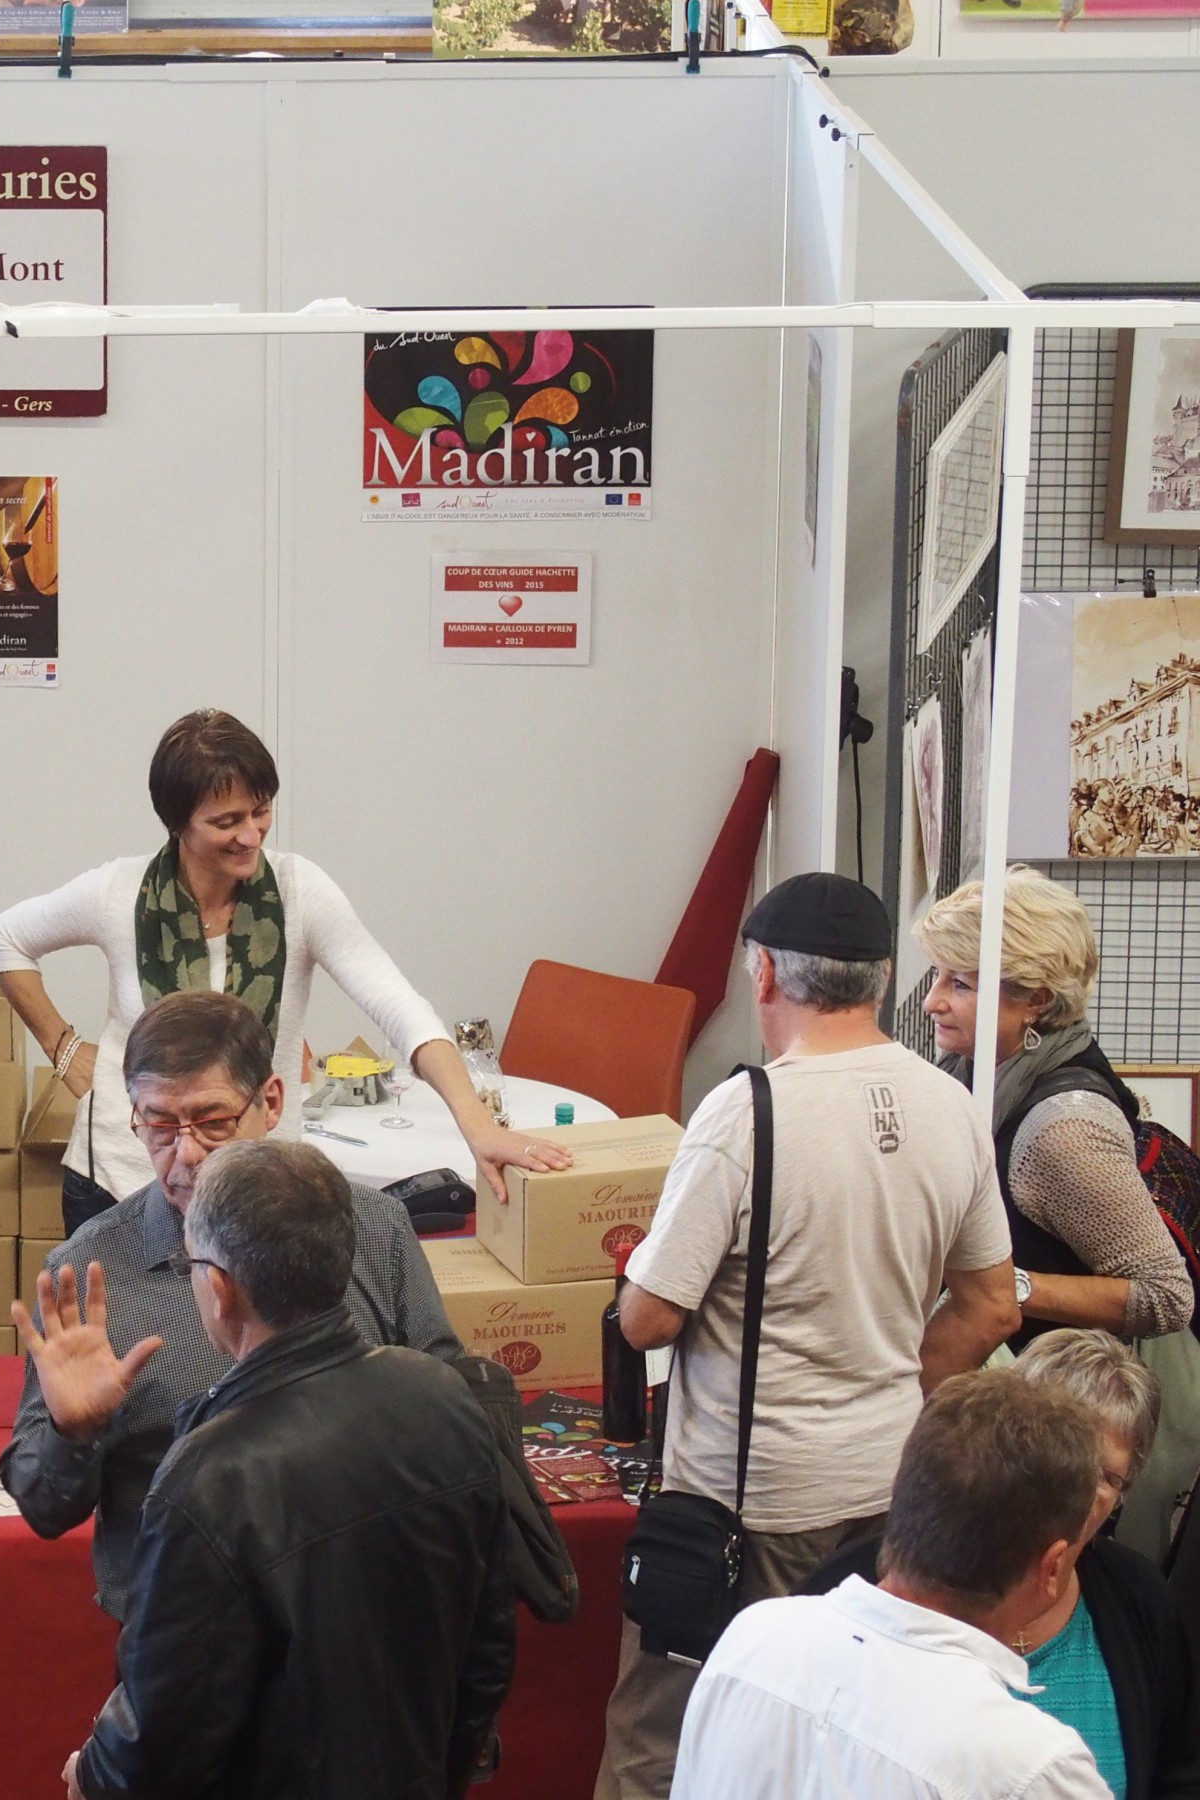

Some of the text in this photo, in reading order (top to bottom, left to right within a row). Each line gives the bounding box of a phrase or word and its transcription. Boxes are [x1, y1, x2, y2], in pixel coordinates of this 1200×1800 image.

[373, 337, 388, 351] du
[14, 396, 53, 411] Gers
[609, 421, 649, 440] émotion
[365, 422, 650, 486] Madiran
[5, 495, 28, 504] secret
[447, 568, 576, 577] COUP DE CŒUR GUIDE HACHETTE
[525, 581, 544, 589] 2015
[448, 625, 486, 633] MADIRAN
[495, 625, 533, 633] CAILLOUX
[535, 625, 545, 633] DE
[547, 625, 572, 633] PYREN
[505, 637, 524, 645] 2012
[591, 1184, 659, 1207] Domaine
[486, 1301, 554, 1323] Domaine
[472, 1322, 567, 1340] MAOURIES
